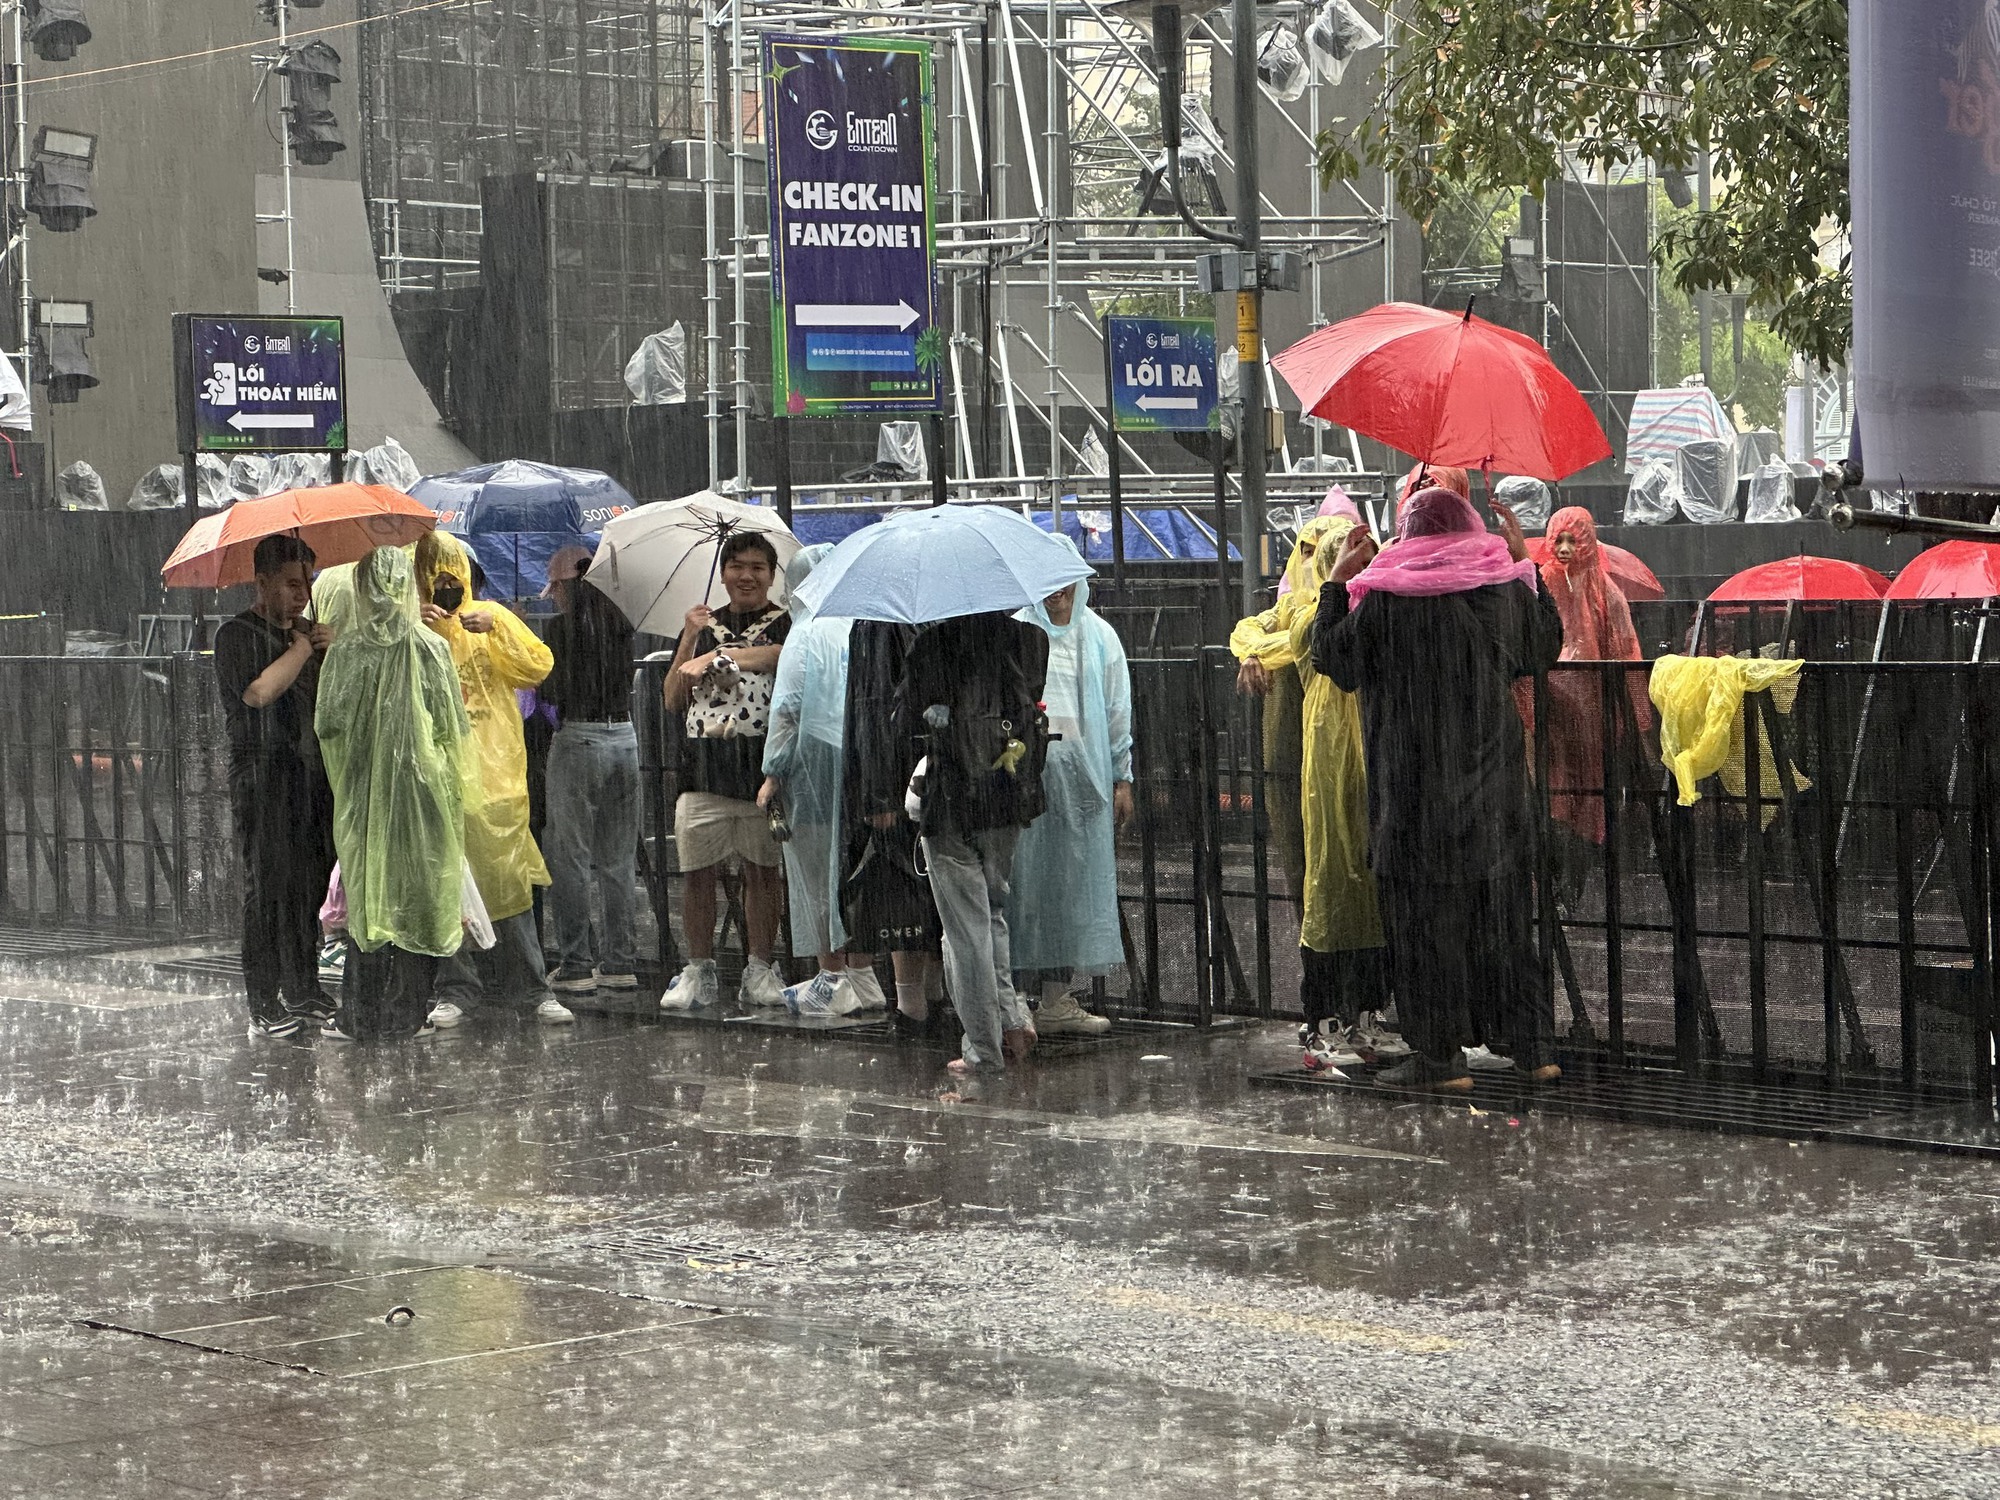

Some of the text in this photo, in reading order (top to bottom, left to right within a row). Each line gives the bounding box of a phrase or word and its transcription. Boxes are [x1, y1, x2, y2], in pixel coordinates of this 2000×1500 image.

[847, 145, 898, 153] COUNTDOWN
[784, 181, 923, 213] CHECK-IN
[238, 362, 265, 382] LỐI
[1125, 356, 1204, 387] LỐI RA
[238, 381, 338, 401] THOÁT HIỂM
[879, 925, 923, 939] OWEN
